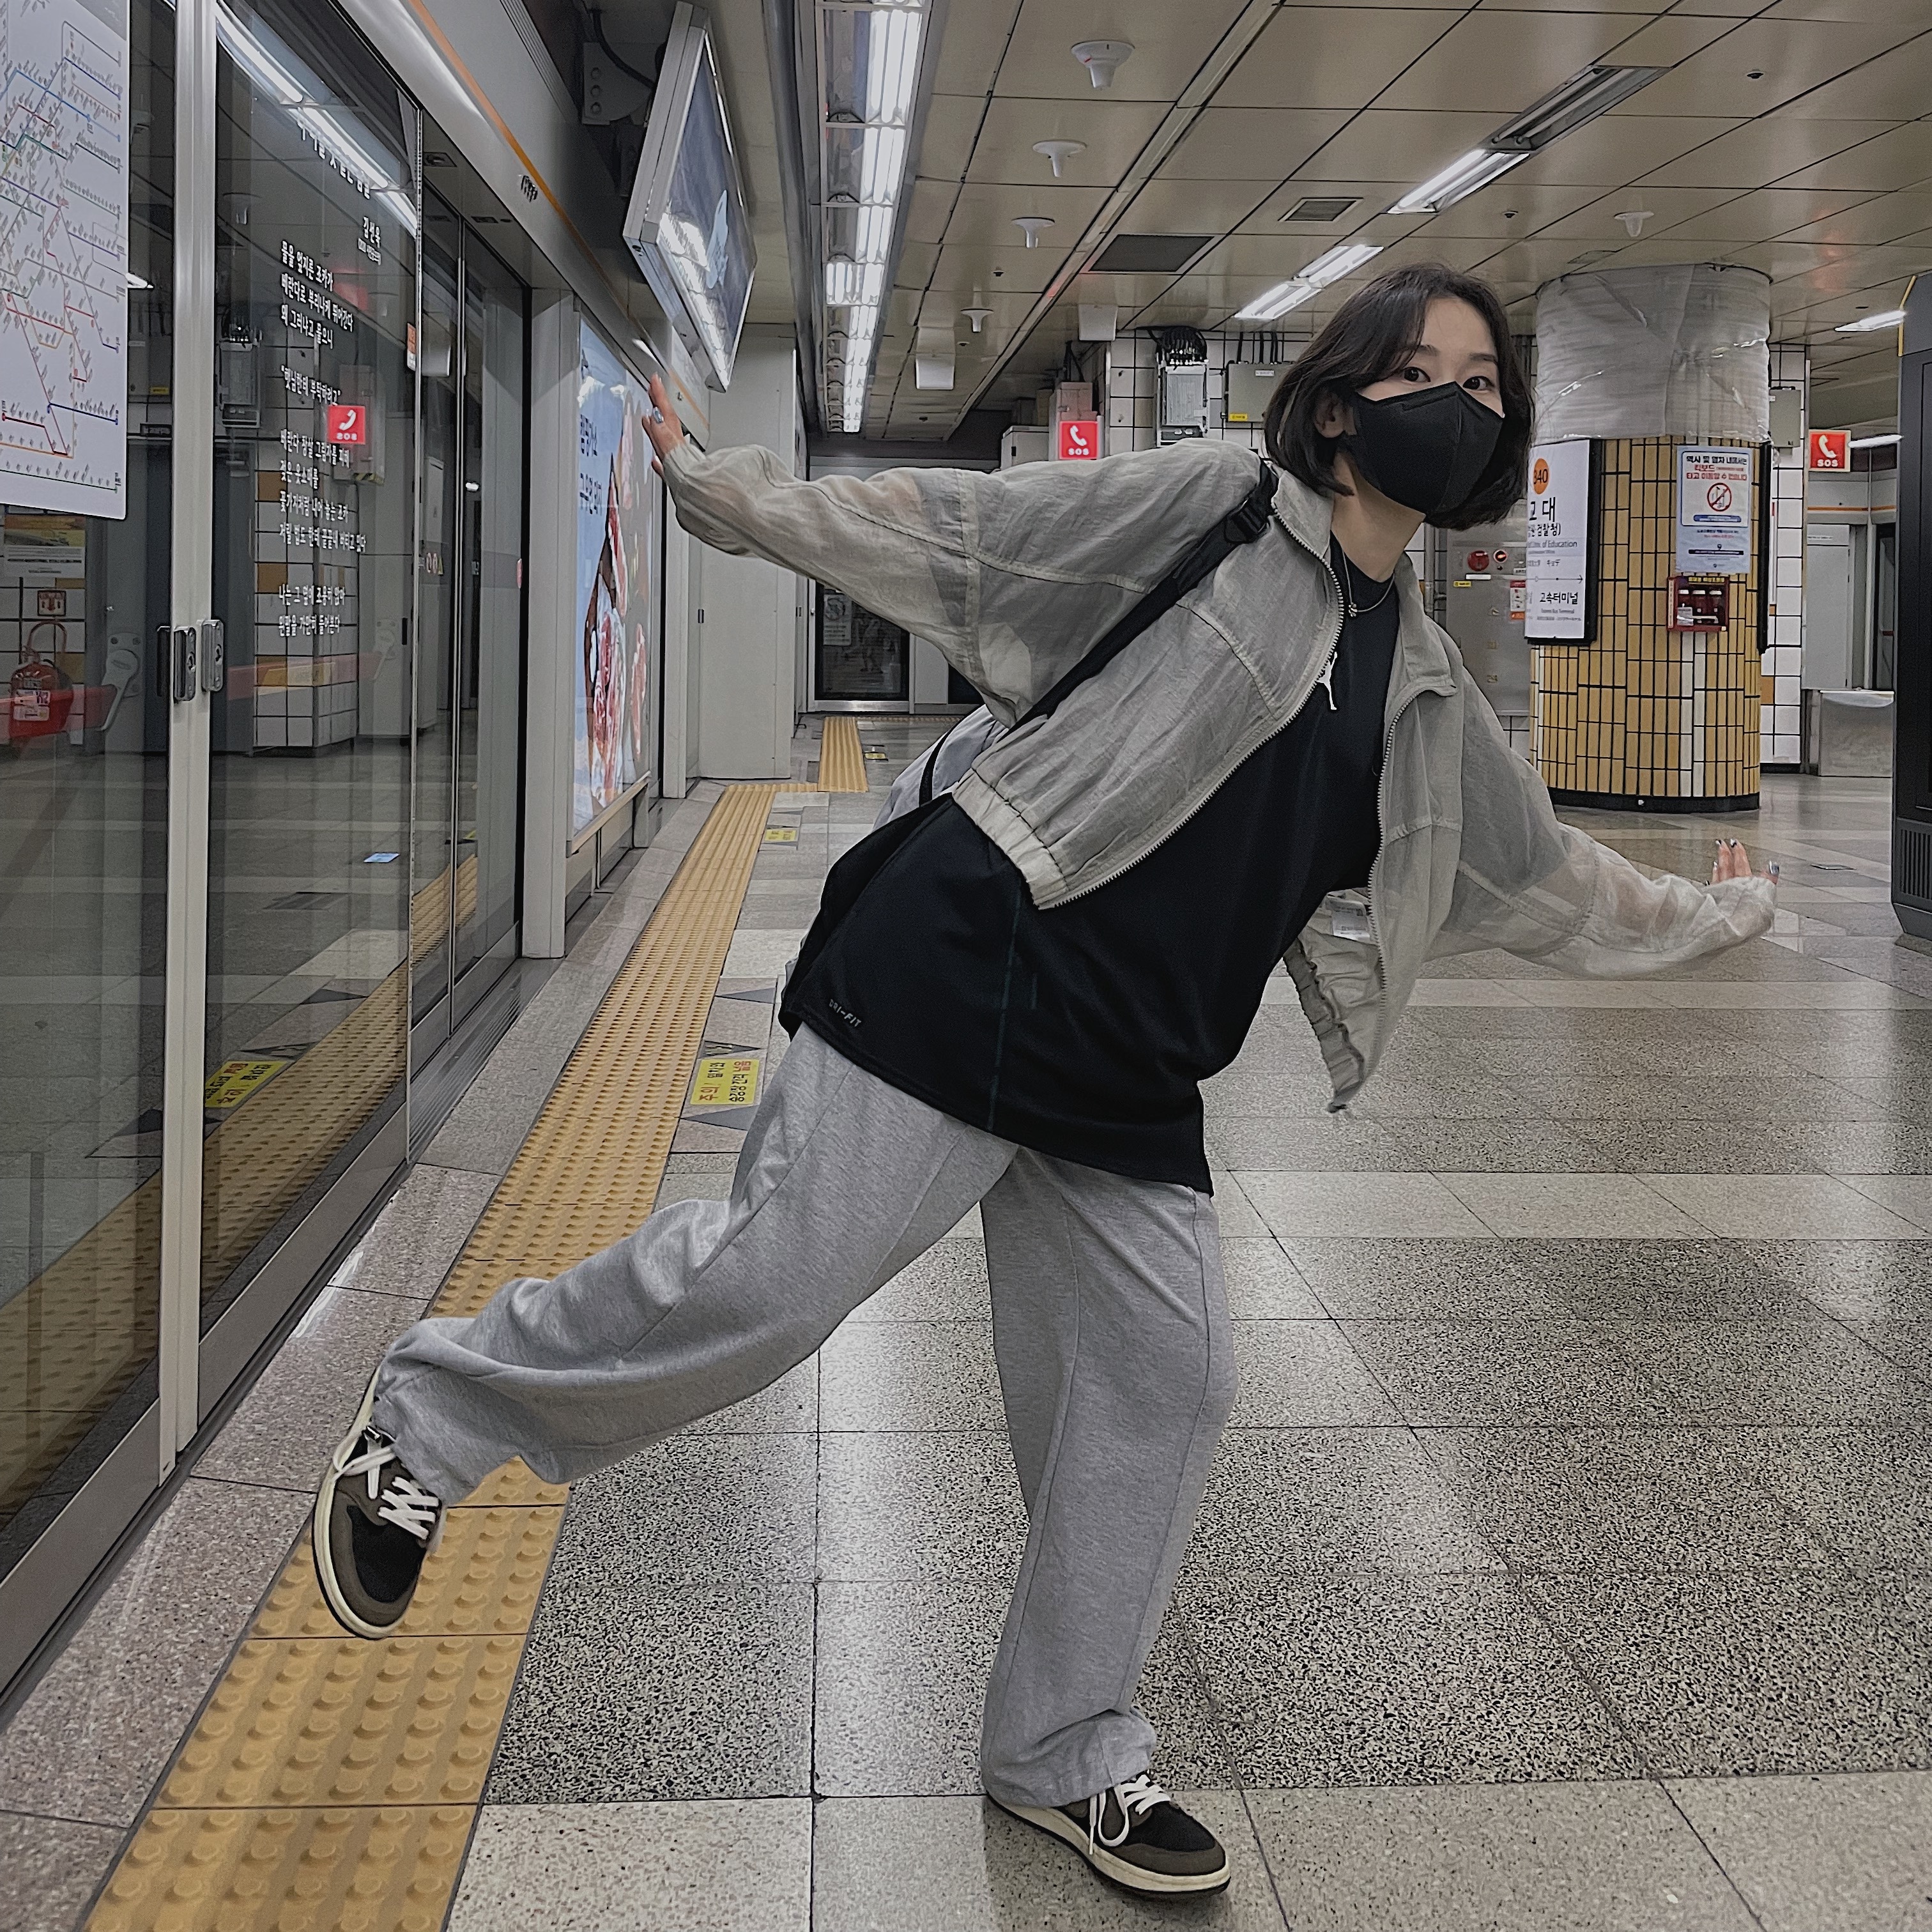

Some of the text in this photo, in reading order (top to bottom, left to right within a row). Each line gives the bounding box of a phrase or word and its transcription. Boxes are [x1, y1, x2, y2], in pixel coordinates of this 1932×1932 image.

[281, 240, 333, 291] 물을 엎지른 조카가
[281, 273, 353, 332] 베란다로 부리나케 뛰어간다
[281, 304, 333, 349] 왜 그러냐고 물으니
[280, 429, 299, 454] 베란다
[315, 441, 337, 465] 그림자를
[280, 460, 293, 483] 젖은
[1817, 459, 1838, 467] SOS
[279, 583, 292, 606] 나는
[294, 586, 301, 603] 그
[316, 585, 333, 606] 조용히
[1540, 592, 1577, 604] 고속터미널
[732, 1074, 749, 1084] 간격
[728, 1085, 747, 1102] 승강장
